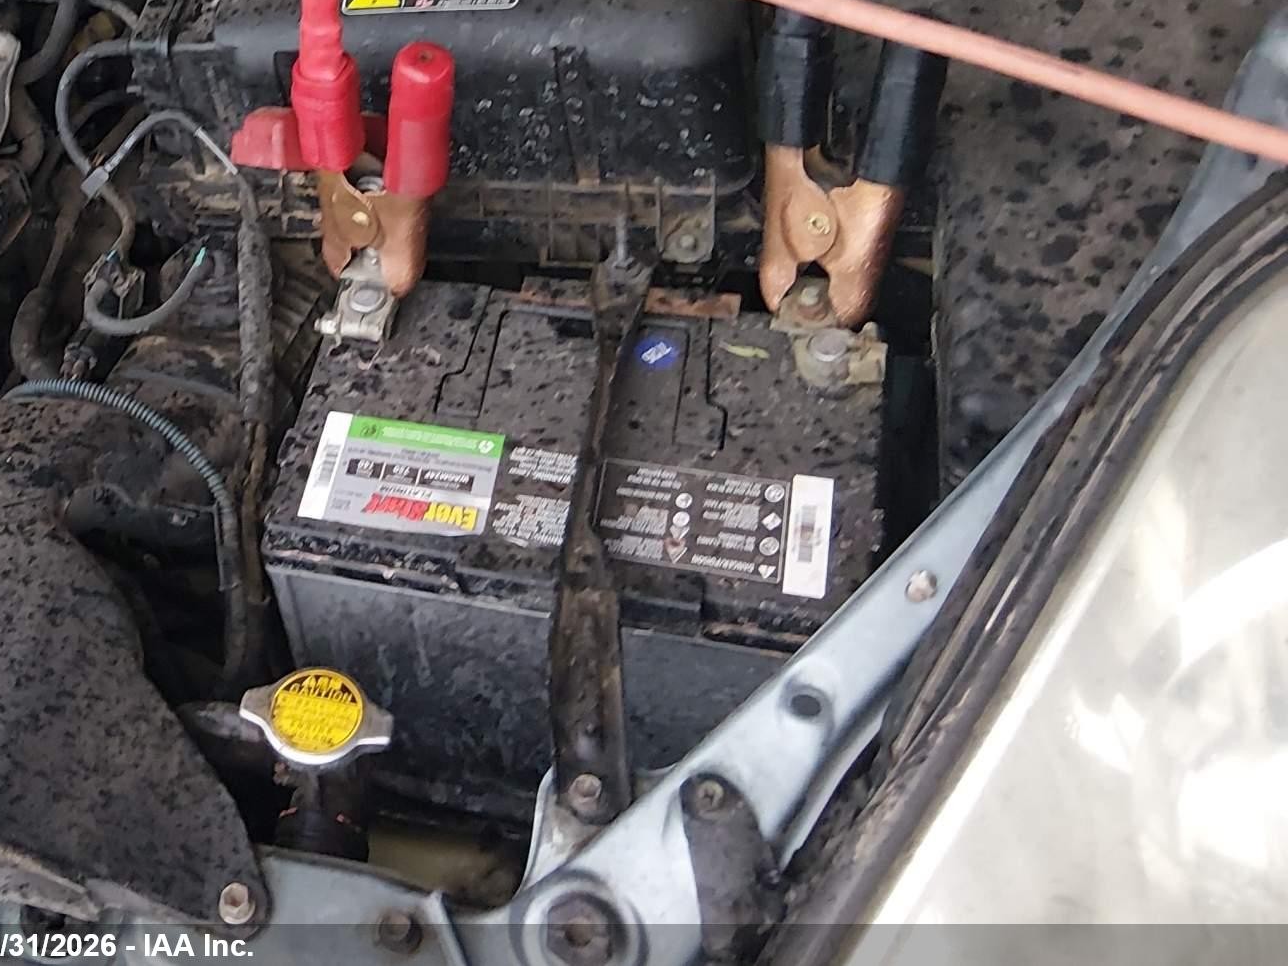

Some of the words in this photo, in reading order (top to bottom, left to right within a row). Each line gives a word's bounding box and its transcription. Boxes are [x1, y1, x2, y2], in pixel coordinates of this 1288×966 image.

[379, 485, 432, 498] PLATINUM
[363, 493, 478, 531] EverStart
[288, 682, 353, 703] CAUTION
